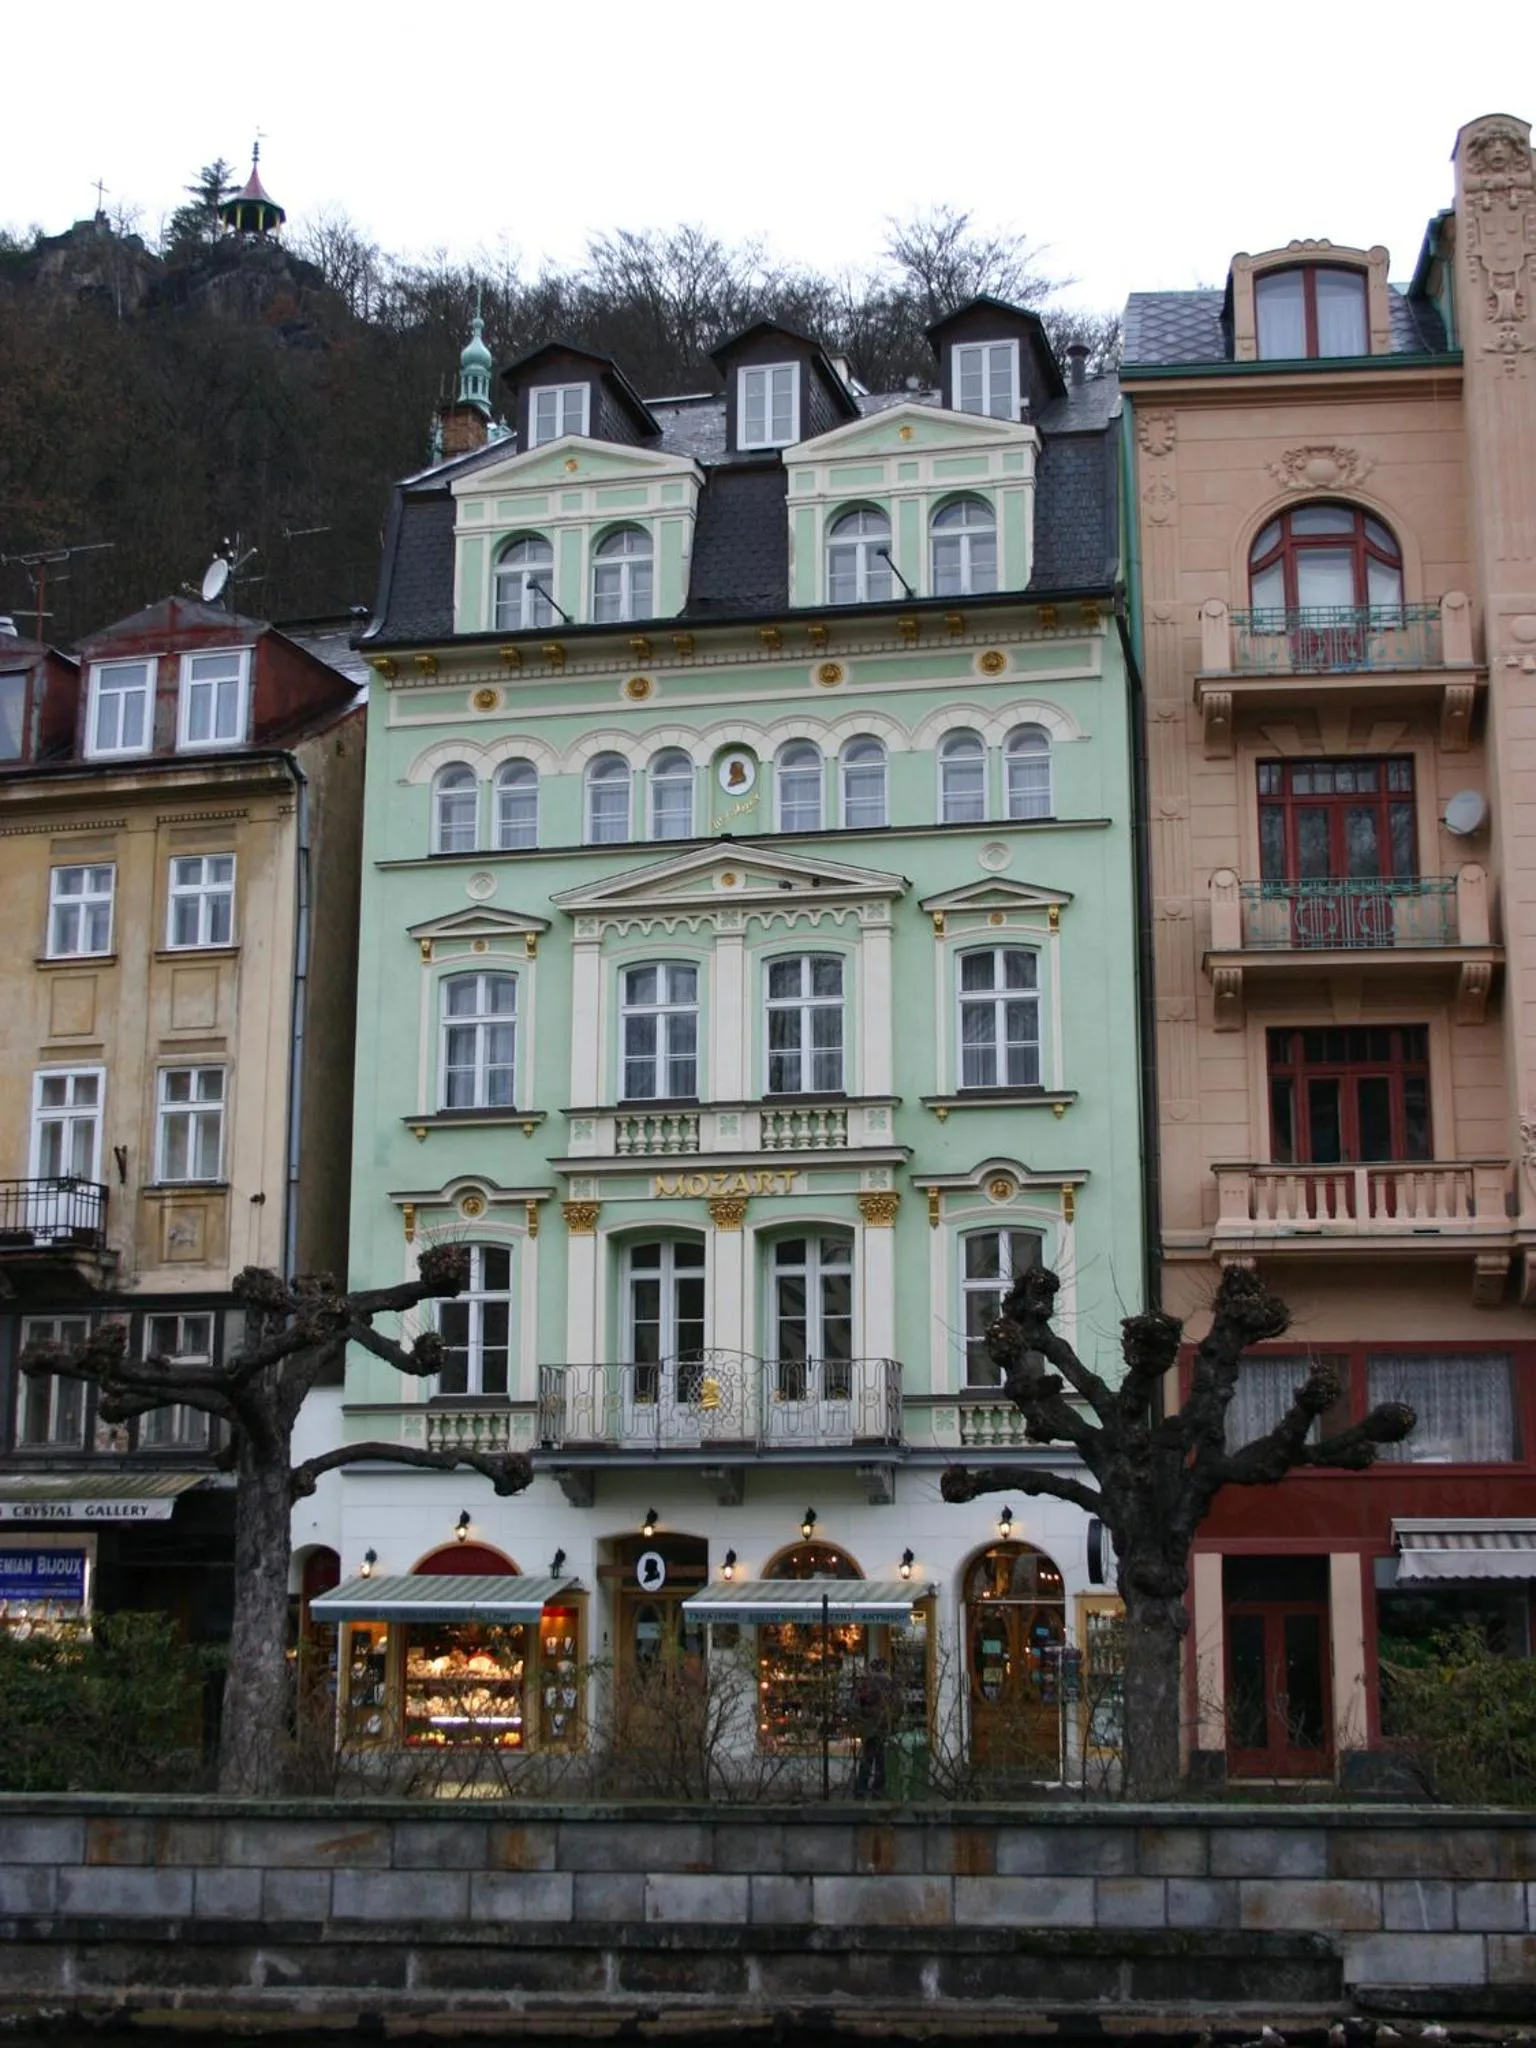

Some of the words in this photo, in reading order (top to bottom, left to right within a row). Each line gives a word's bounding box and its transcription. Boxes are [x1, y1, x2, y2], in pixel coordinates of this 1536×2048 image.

[654, 1168, 800, 1198] MOZART
[12, 1504, 73, 1518] CRYSTAL
[84, 1503, 149, 1517] GALLERY
